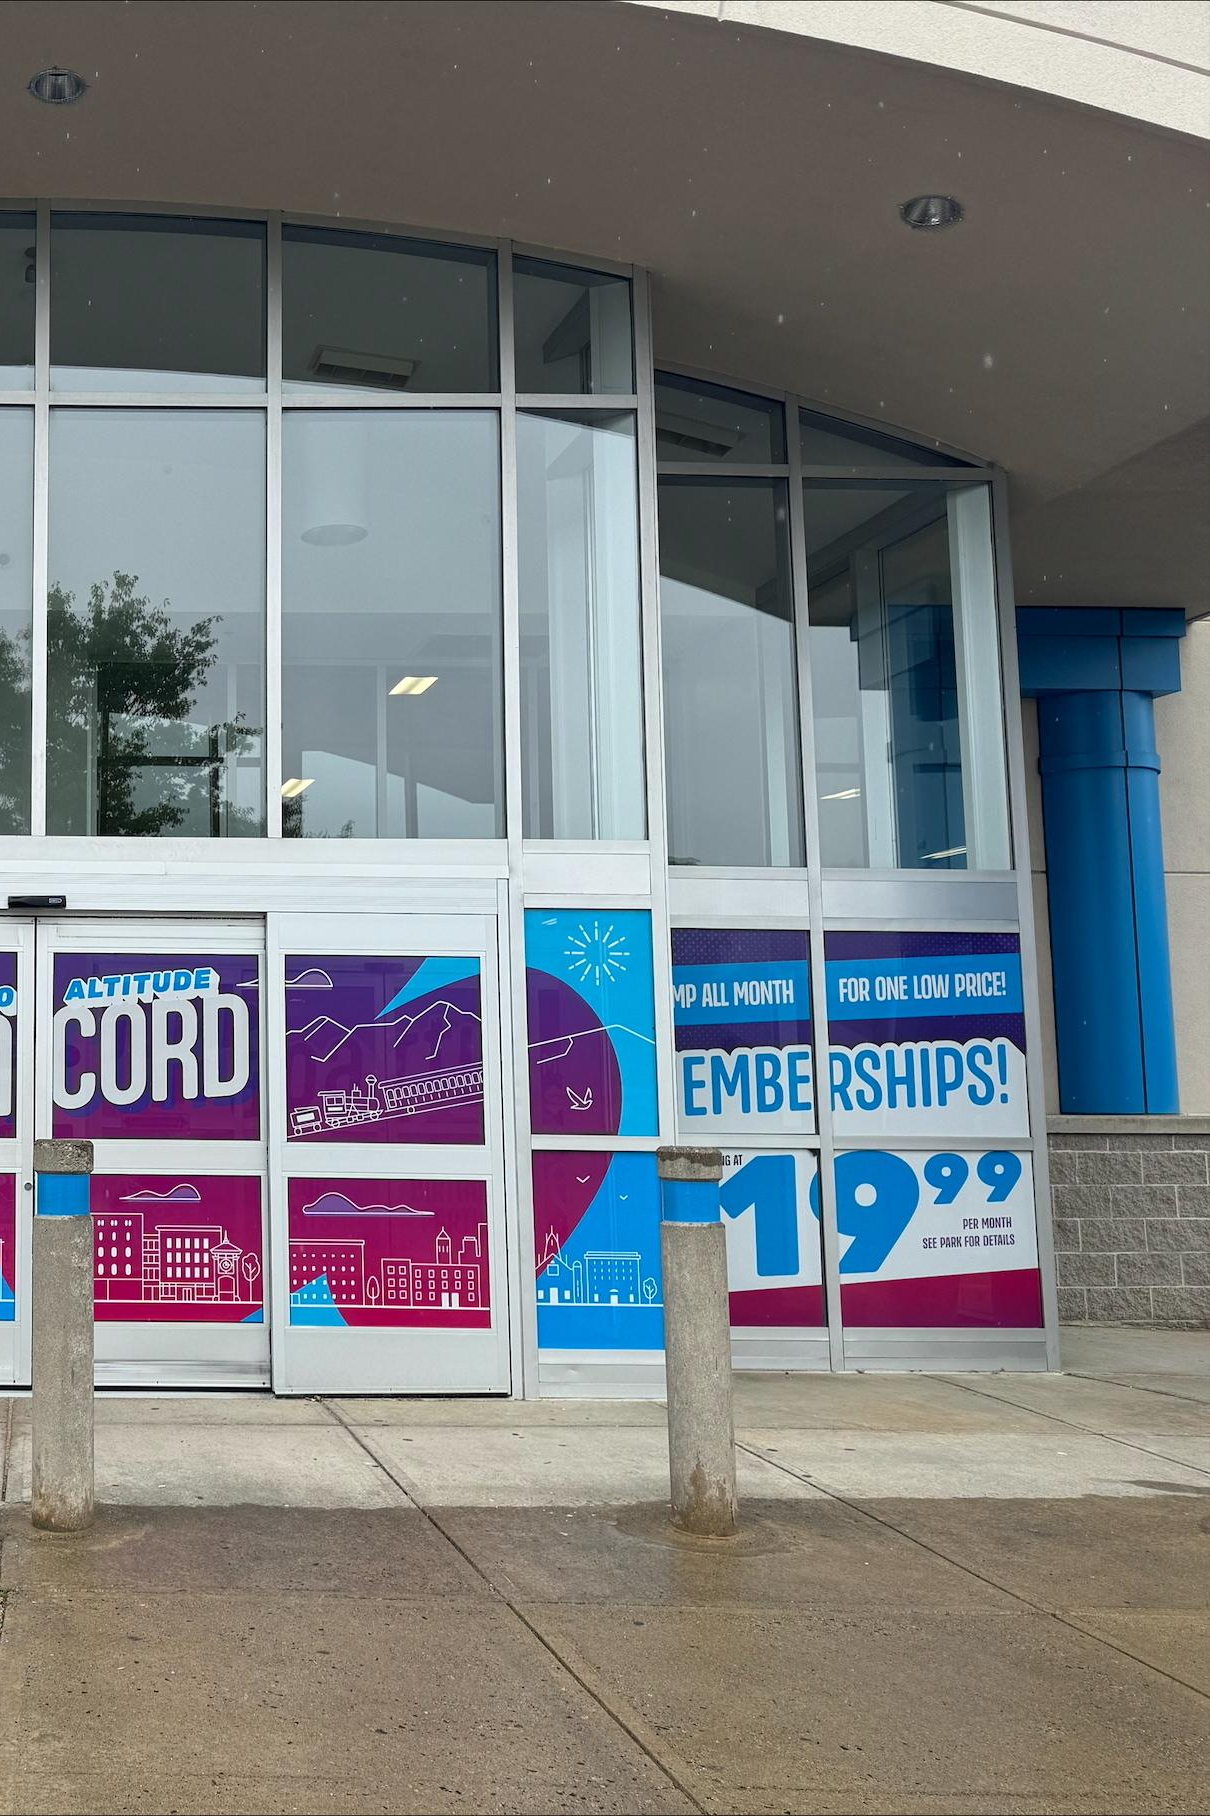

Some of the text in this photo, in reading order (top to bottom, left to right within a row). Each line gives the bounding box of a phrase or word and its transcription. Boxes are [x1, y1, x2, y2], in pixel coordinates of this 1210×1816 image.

[65, 968, 212, 1001] ALTITUDE
[701, 982, 730, 1007] ALL
[733, 979, 795, 1006] MONTH
[838, 977, 870, 1003] FOR
[875, 975, 908, 1001] ONE
[913, 974, 950, 1000] LOW
[954, 971, 1007, 998] PRICE!
[733, 1154, 743, 1166] AT
[962, 1216, 1012, 1230] PER MONTH
[922, 1233, 1015, 1249] SEE PARK FOR DETAILS
